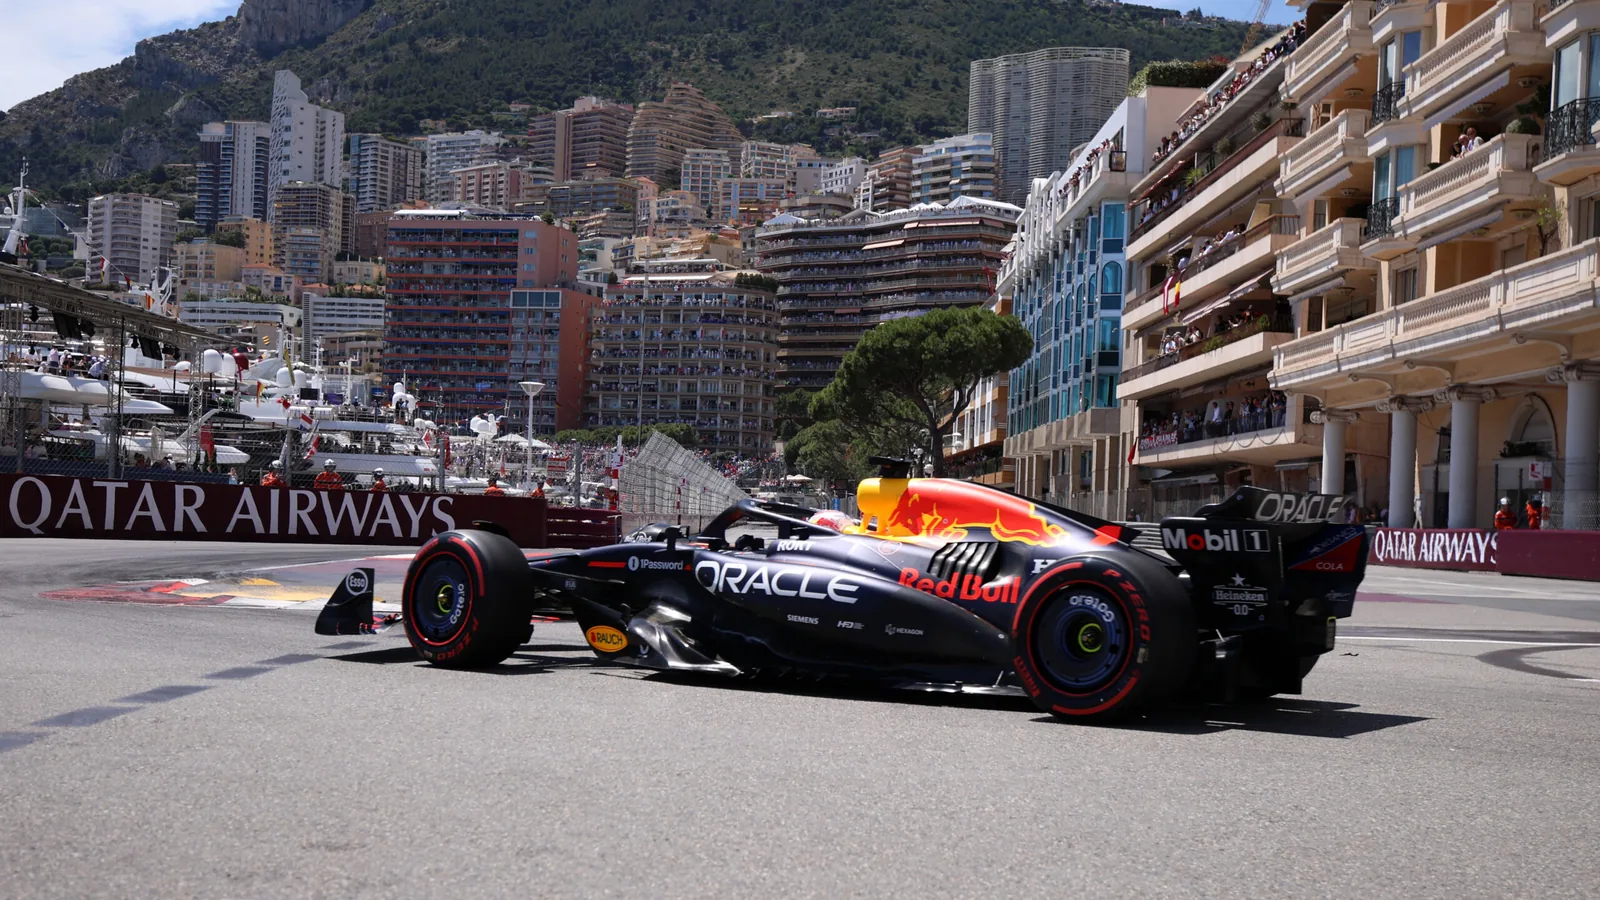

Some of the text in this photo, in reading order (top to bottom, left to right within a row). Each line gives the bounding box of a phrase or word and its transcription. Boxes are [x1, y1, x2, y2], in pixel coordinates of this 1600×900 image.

[9, 476, 456, 538] QATAR AIRWAYS
[1255, 493, 1344, 523] ORACLE
[1161, 528, 1261, 552] Mobil 1
[1374, 530, 1499, 565] QATAR AIRWAYS
[640, 559, 683, 571] 1Password
[1316, 561, 1343, 570] COLA
[349, 575, 365, 588] Esso
[695, 560, 864, 604] ORACLE
[899, 567, 1021, 604] Red Bull
[450, 583, 465, 625] Gate.io
[1215, 590, 1265, 602] Heineken
[787, 614, 819, 625] SIEMENS
[596, 632, 623, 646] RAUCH
